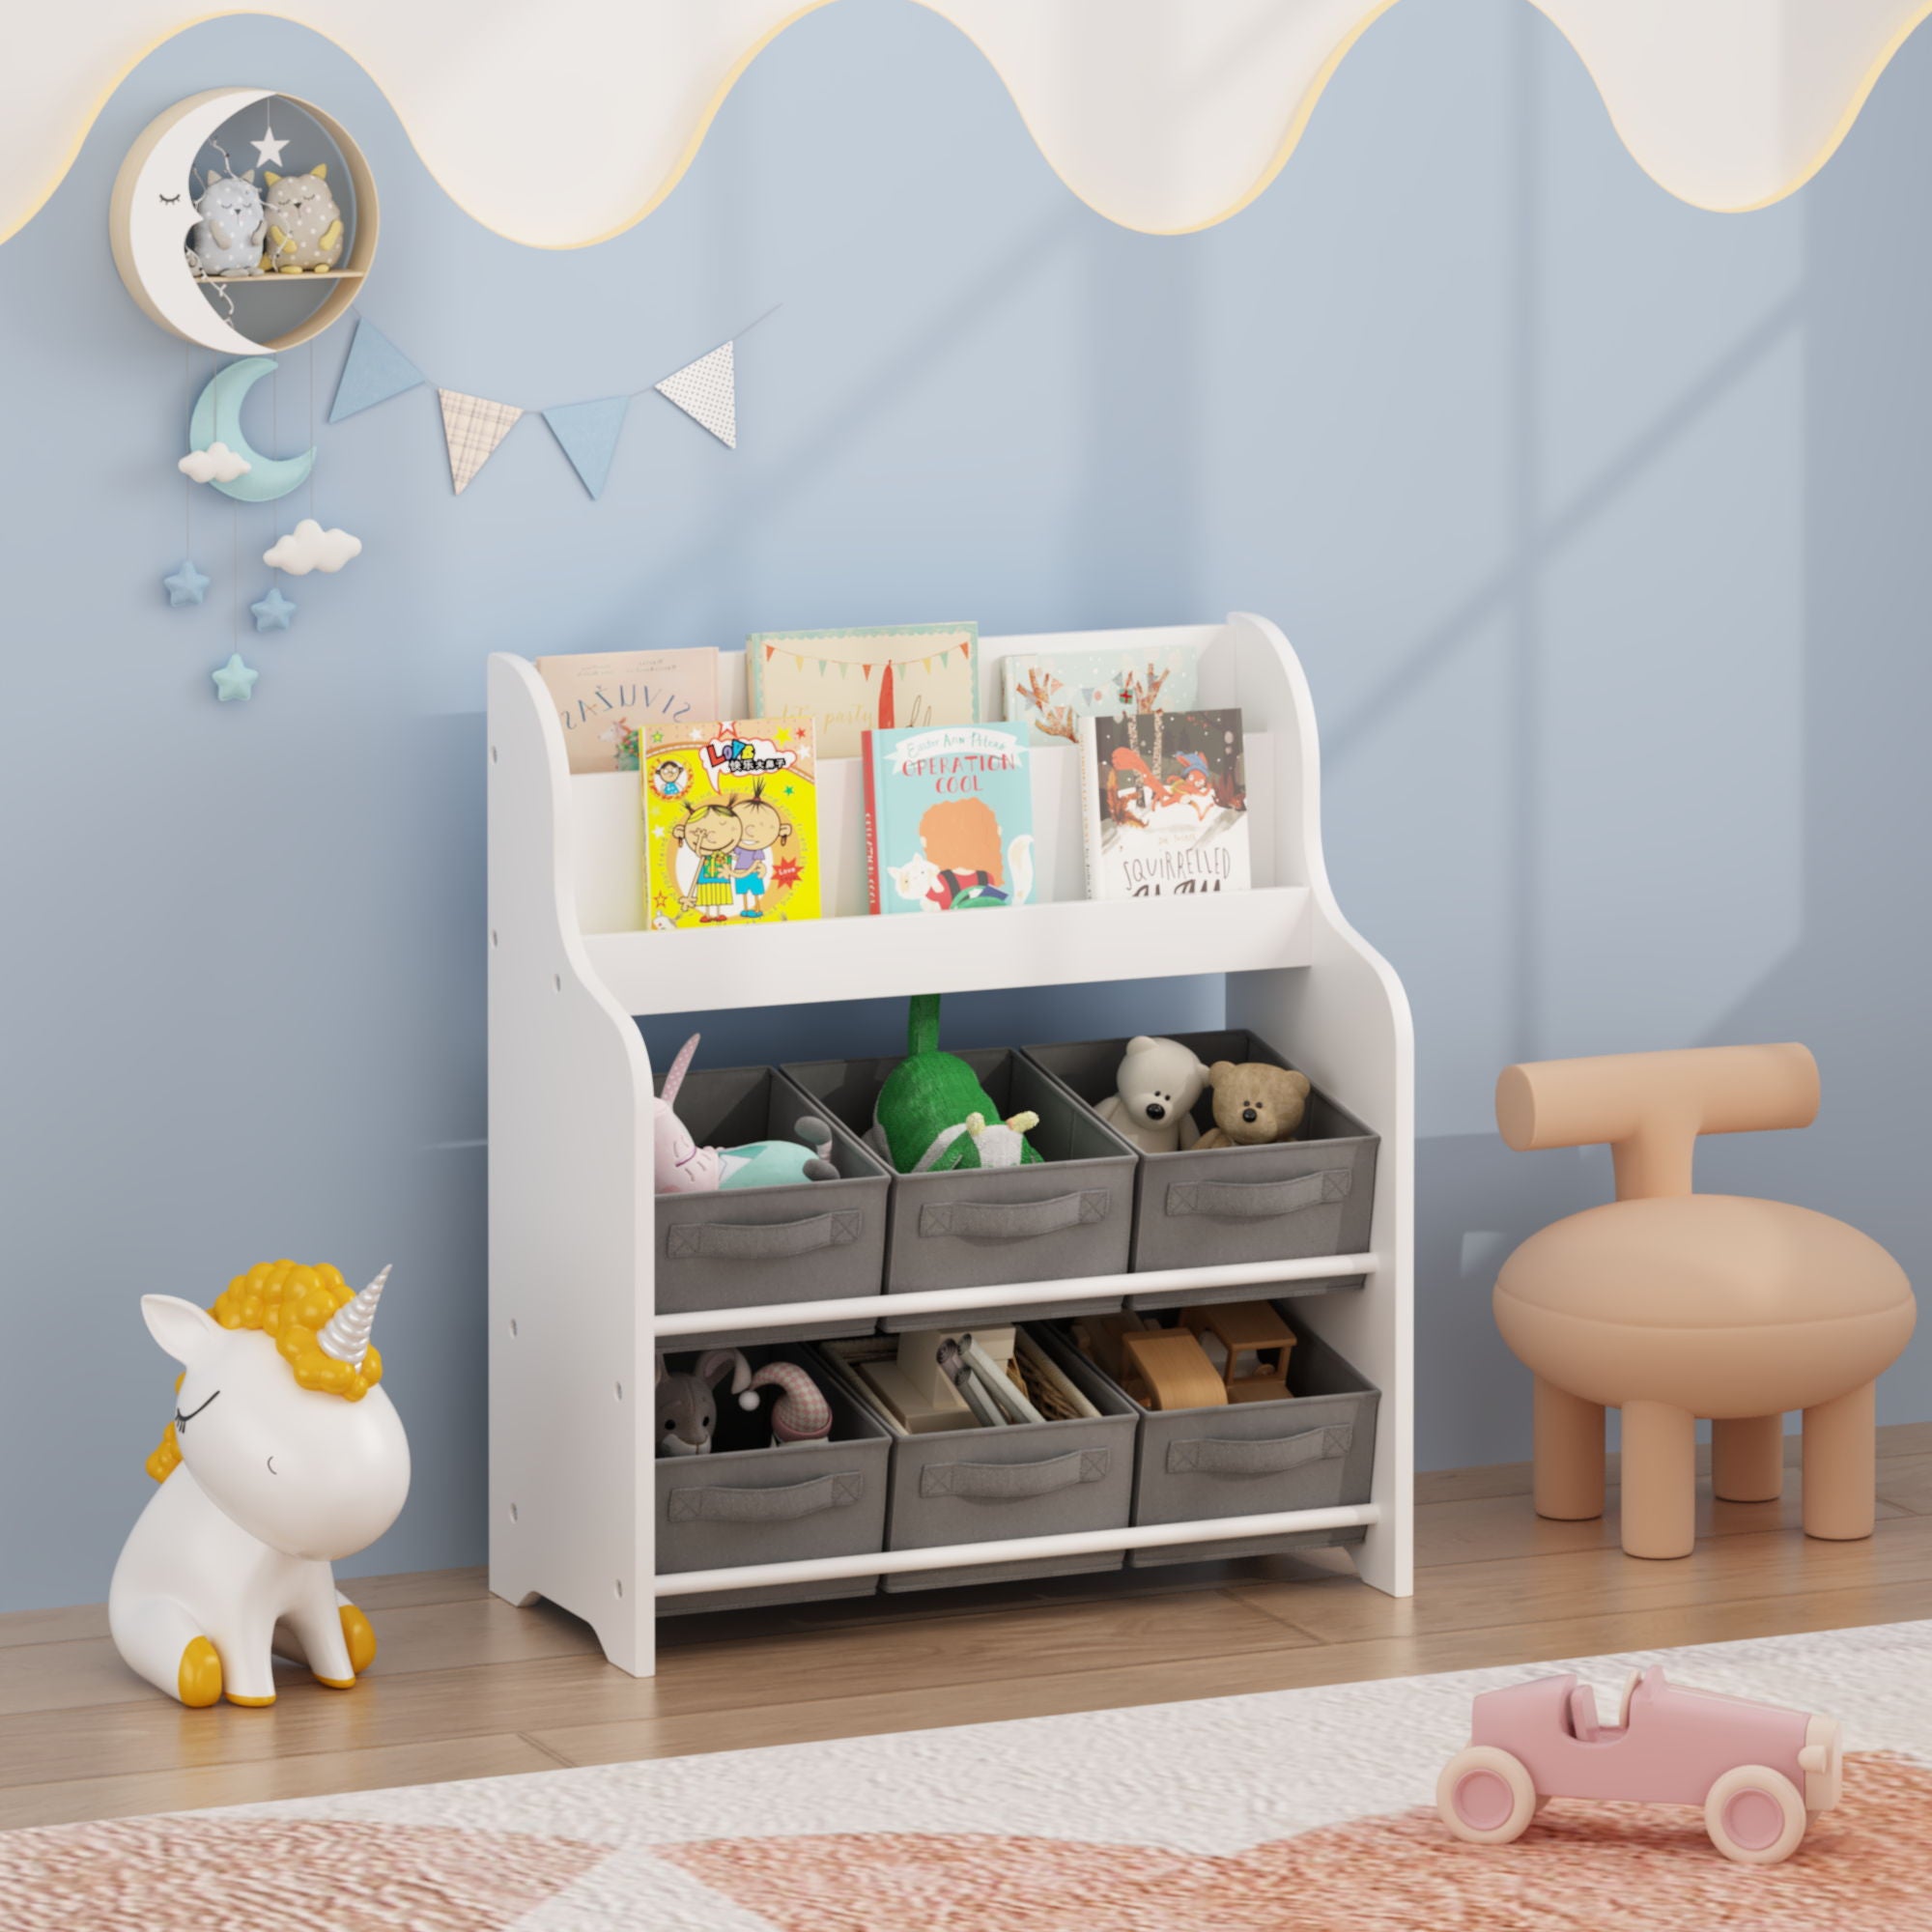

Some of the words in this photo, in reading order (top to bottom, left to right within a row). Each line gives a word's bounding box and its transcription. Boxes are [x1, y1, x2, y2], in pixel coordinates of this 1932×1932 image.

[902, 753, 1015, 777] OPERATION
[935, 775, 984, 794] COOL
[1122, 847, 1232, 891] SQUIRRELLED
